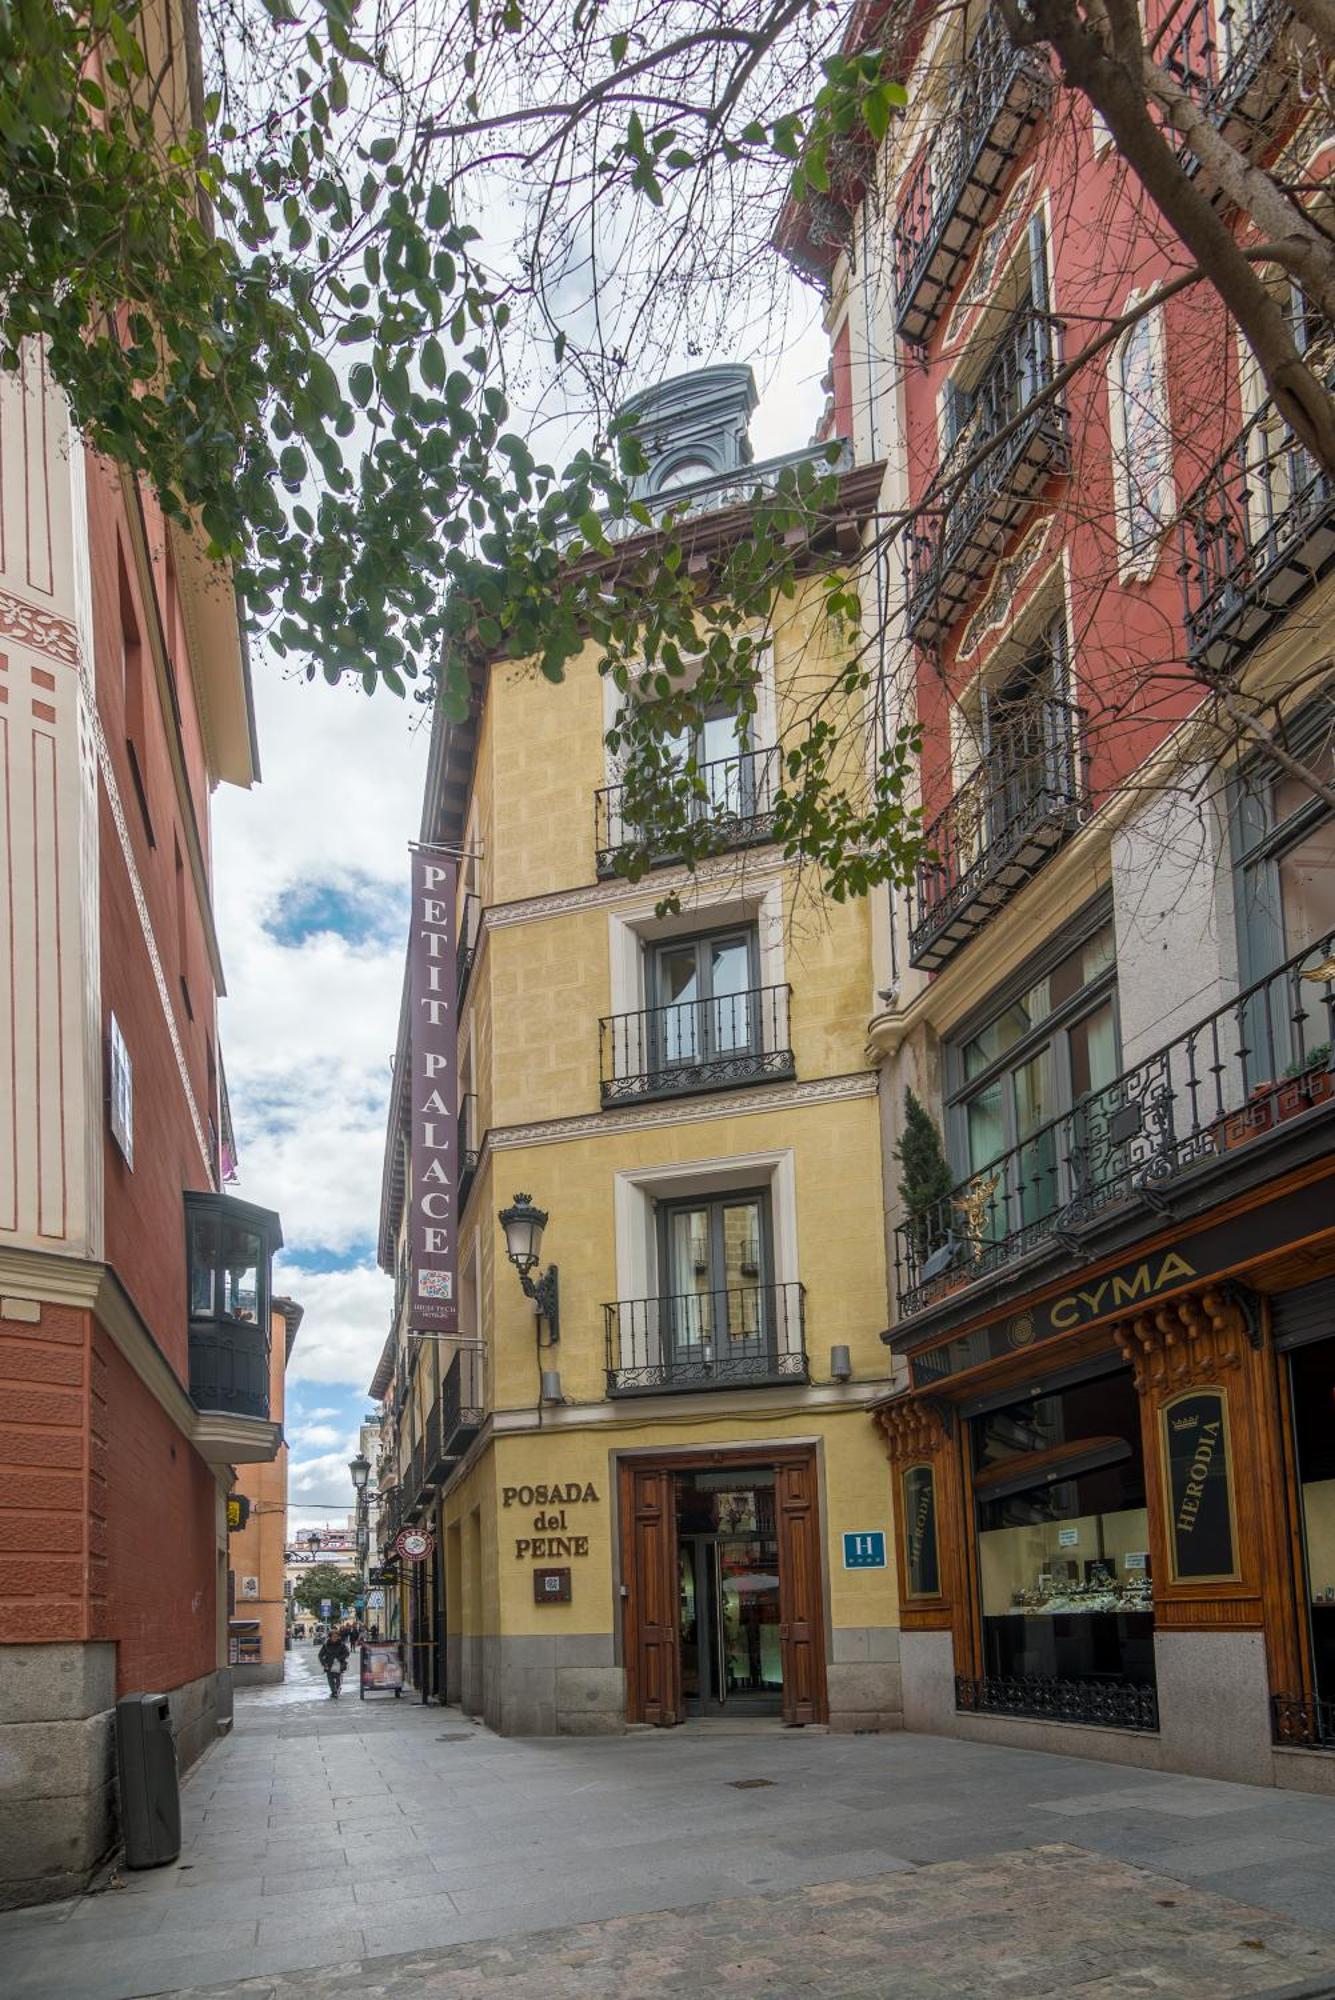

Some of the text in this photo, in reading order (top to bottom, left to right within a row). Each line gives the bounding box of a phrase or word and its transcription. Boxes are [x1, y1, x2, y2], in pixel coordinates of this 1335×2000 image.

[420, 864, 451, 1255] PETIT PALACE
[1050, 1252, 1198, 1328] CYMA
[1177, 1421, 1220, 1532] HERODIA
[502, 1482, 600, 1508] POSADA
[533, 1510, 567, 1532] del
[515, 1536, 589, 1560] PEINE
[855, 1536, 873, 1555] H
